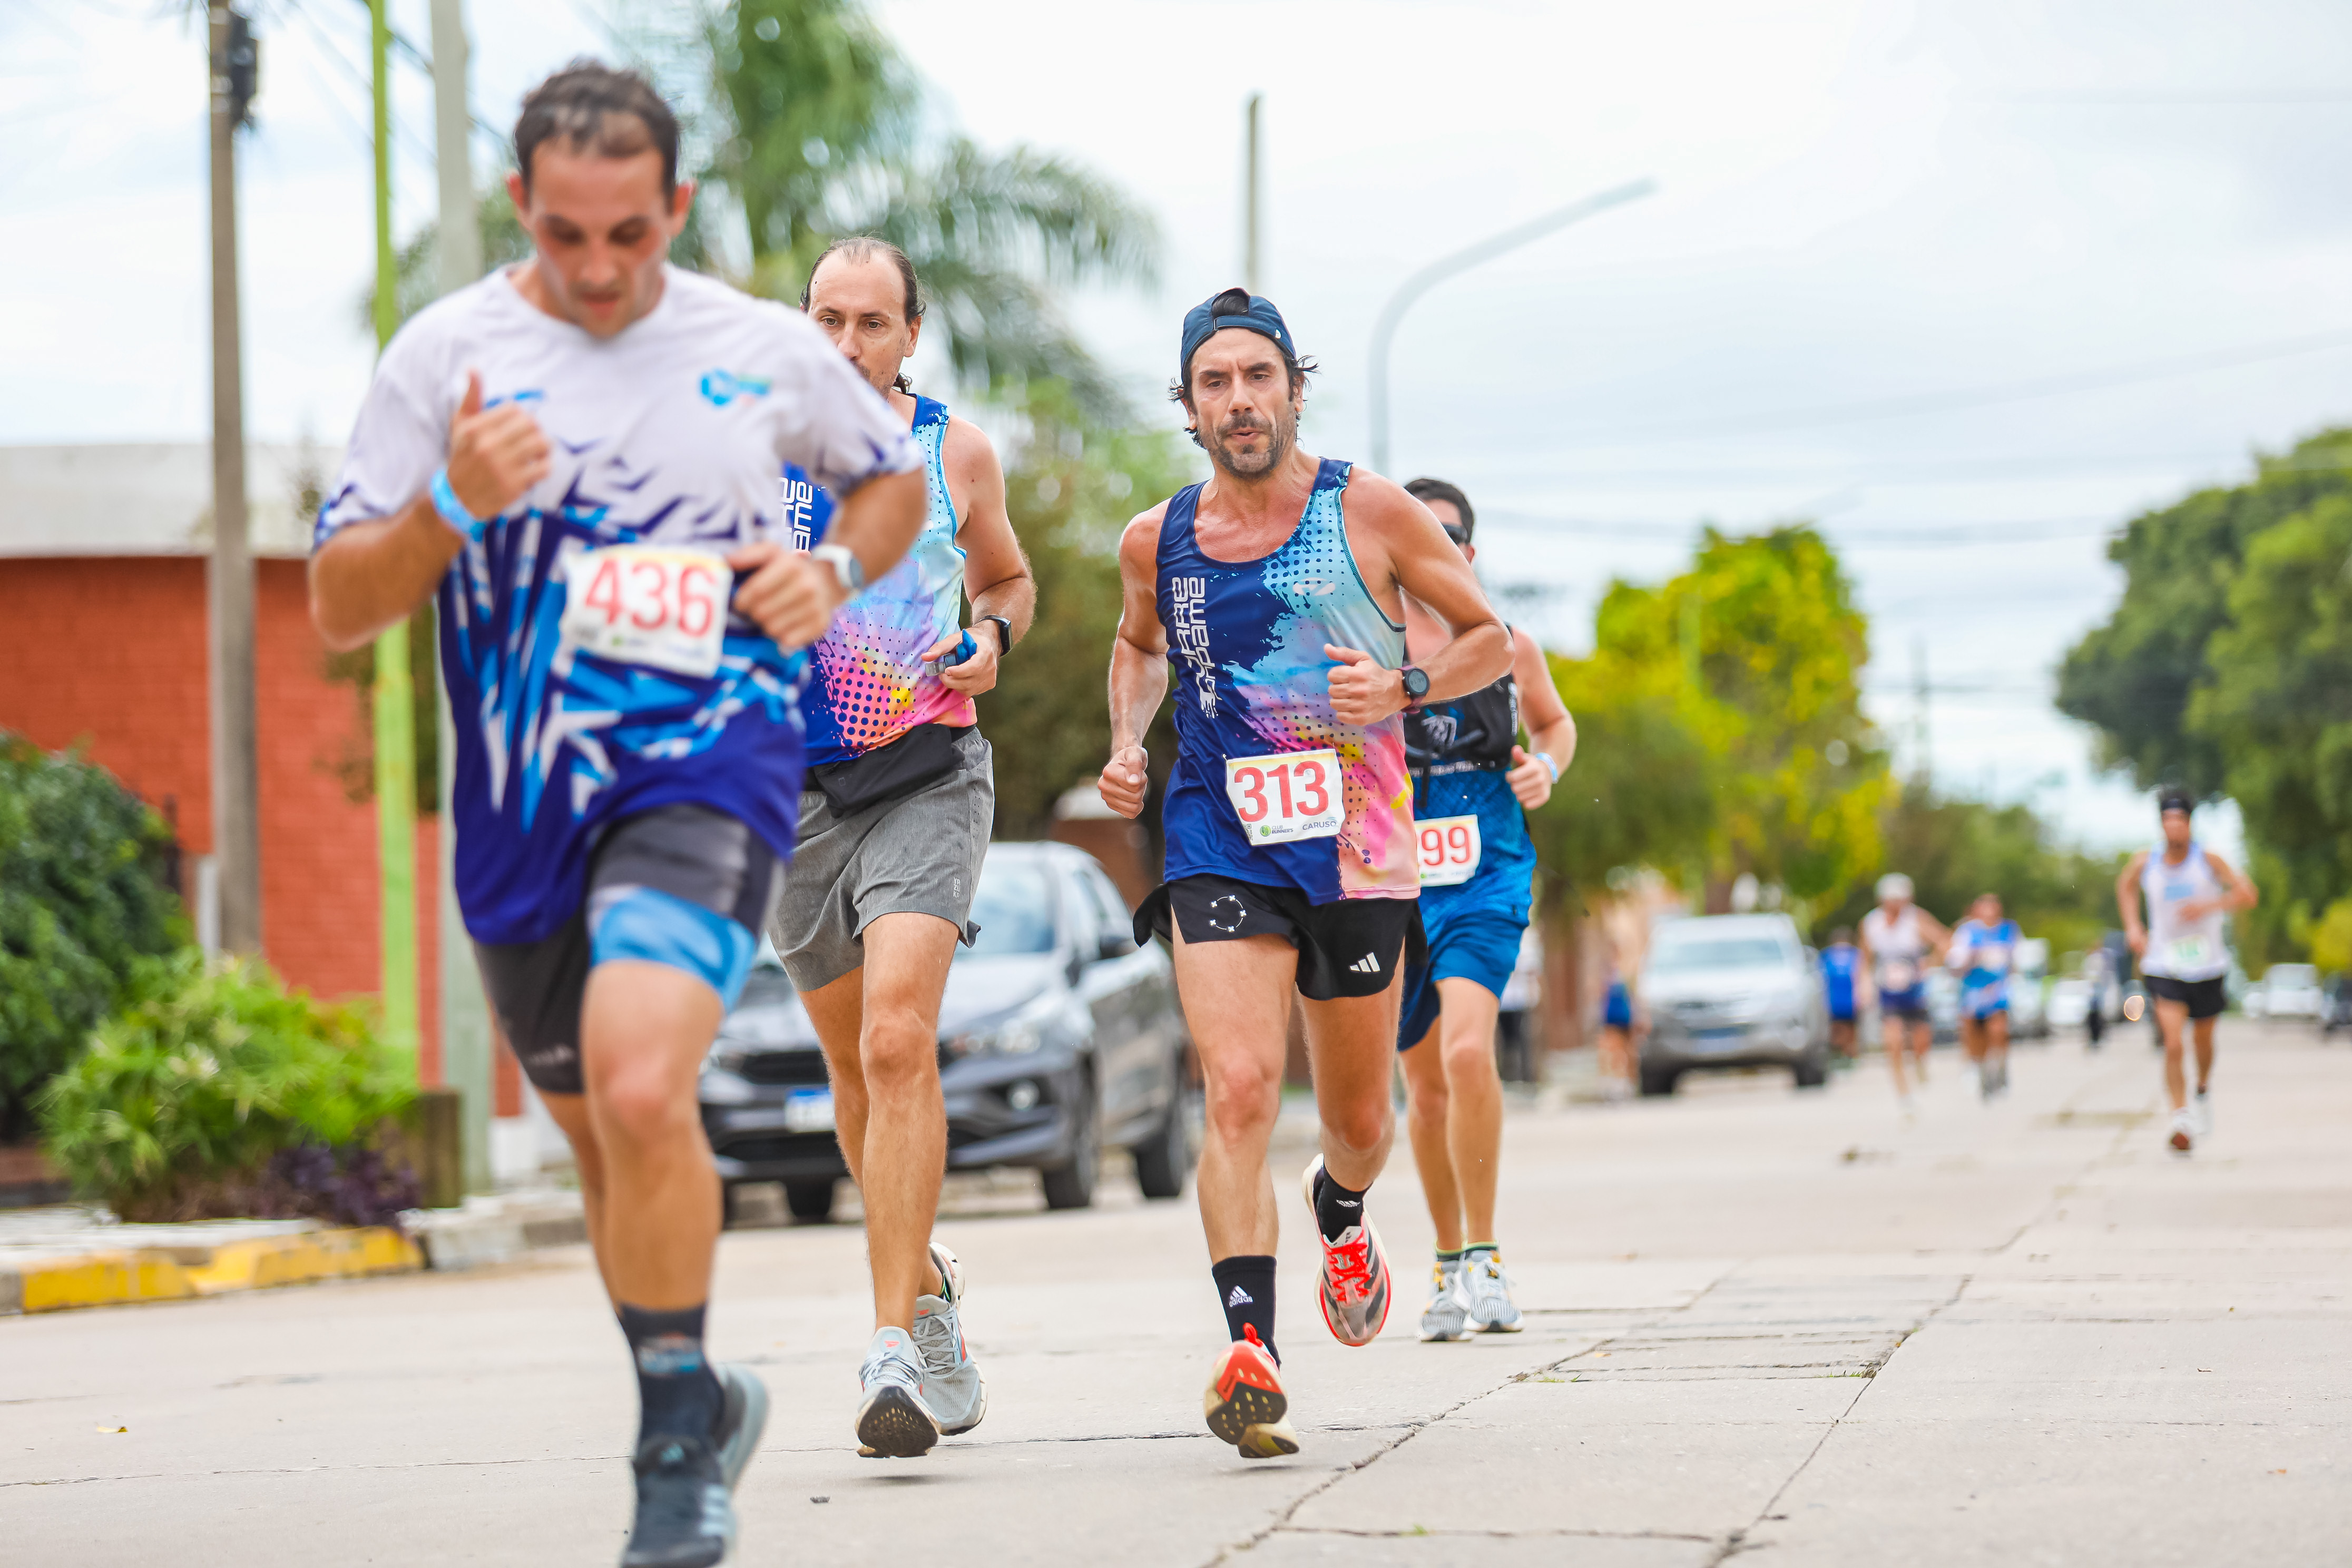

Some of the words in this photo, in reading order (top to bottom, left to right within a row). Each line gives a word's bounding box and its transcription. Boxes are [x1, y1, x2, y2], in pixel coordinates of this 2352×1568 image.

[585, 557, 718, 638] 436
[1234, 760, 1329, 822] 313
[1302, 820, 1337, 830] CARUSO
[1417, 826, 1470, 866] 99
